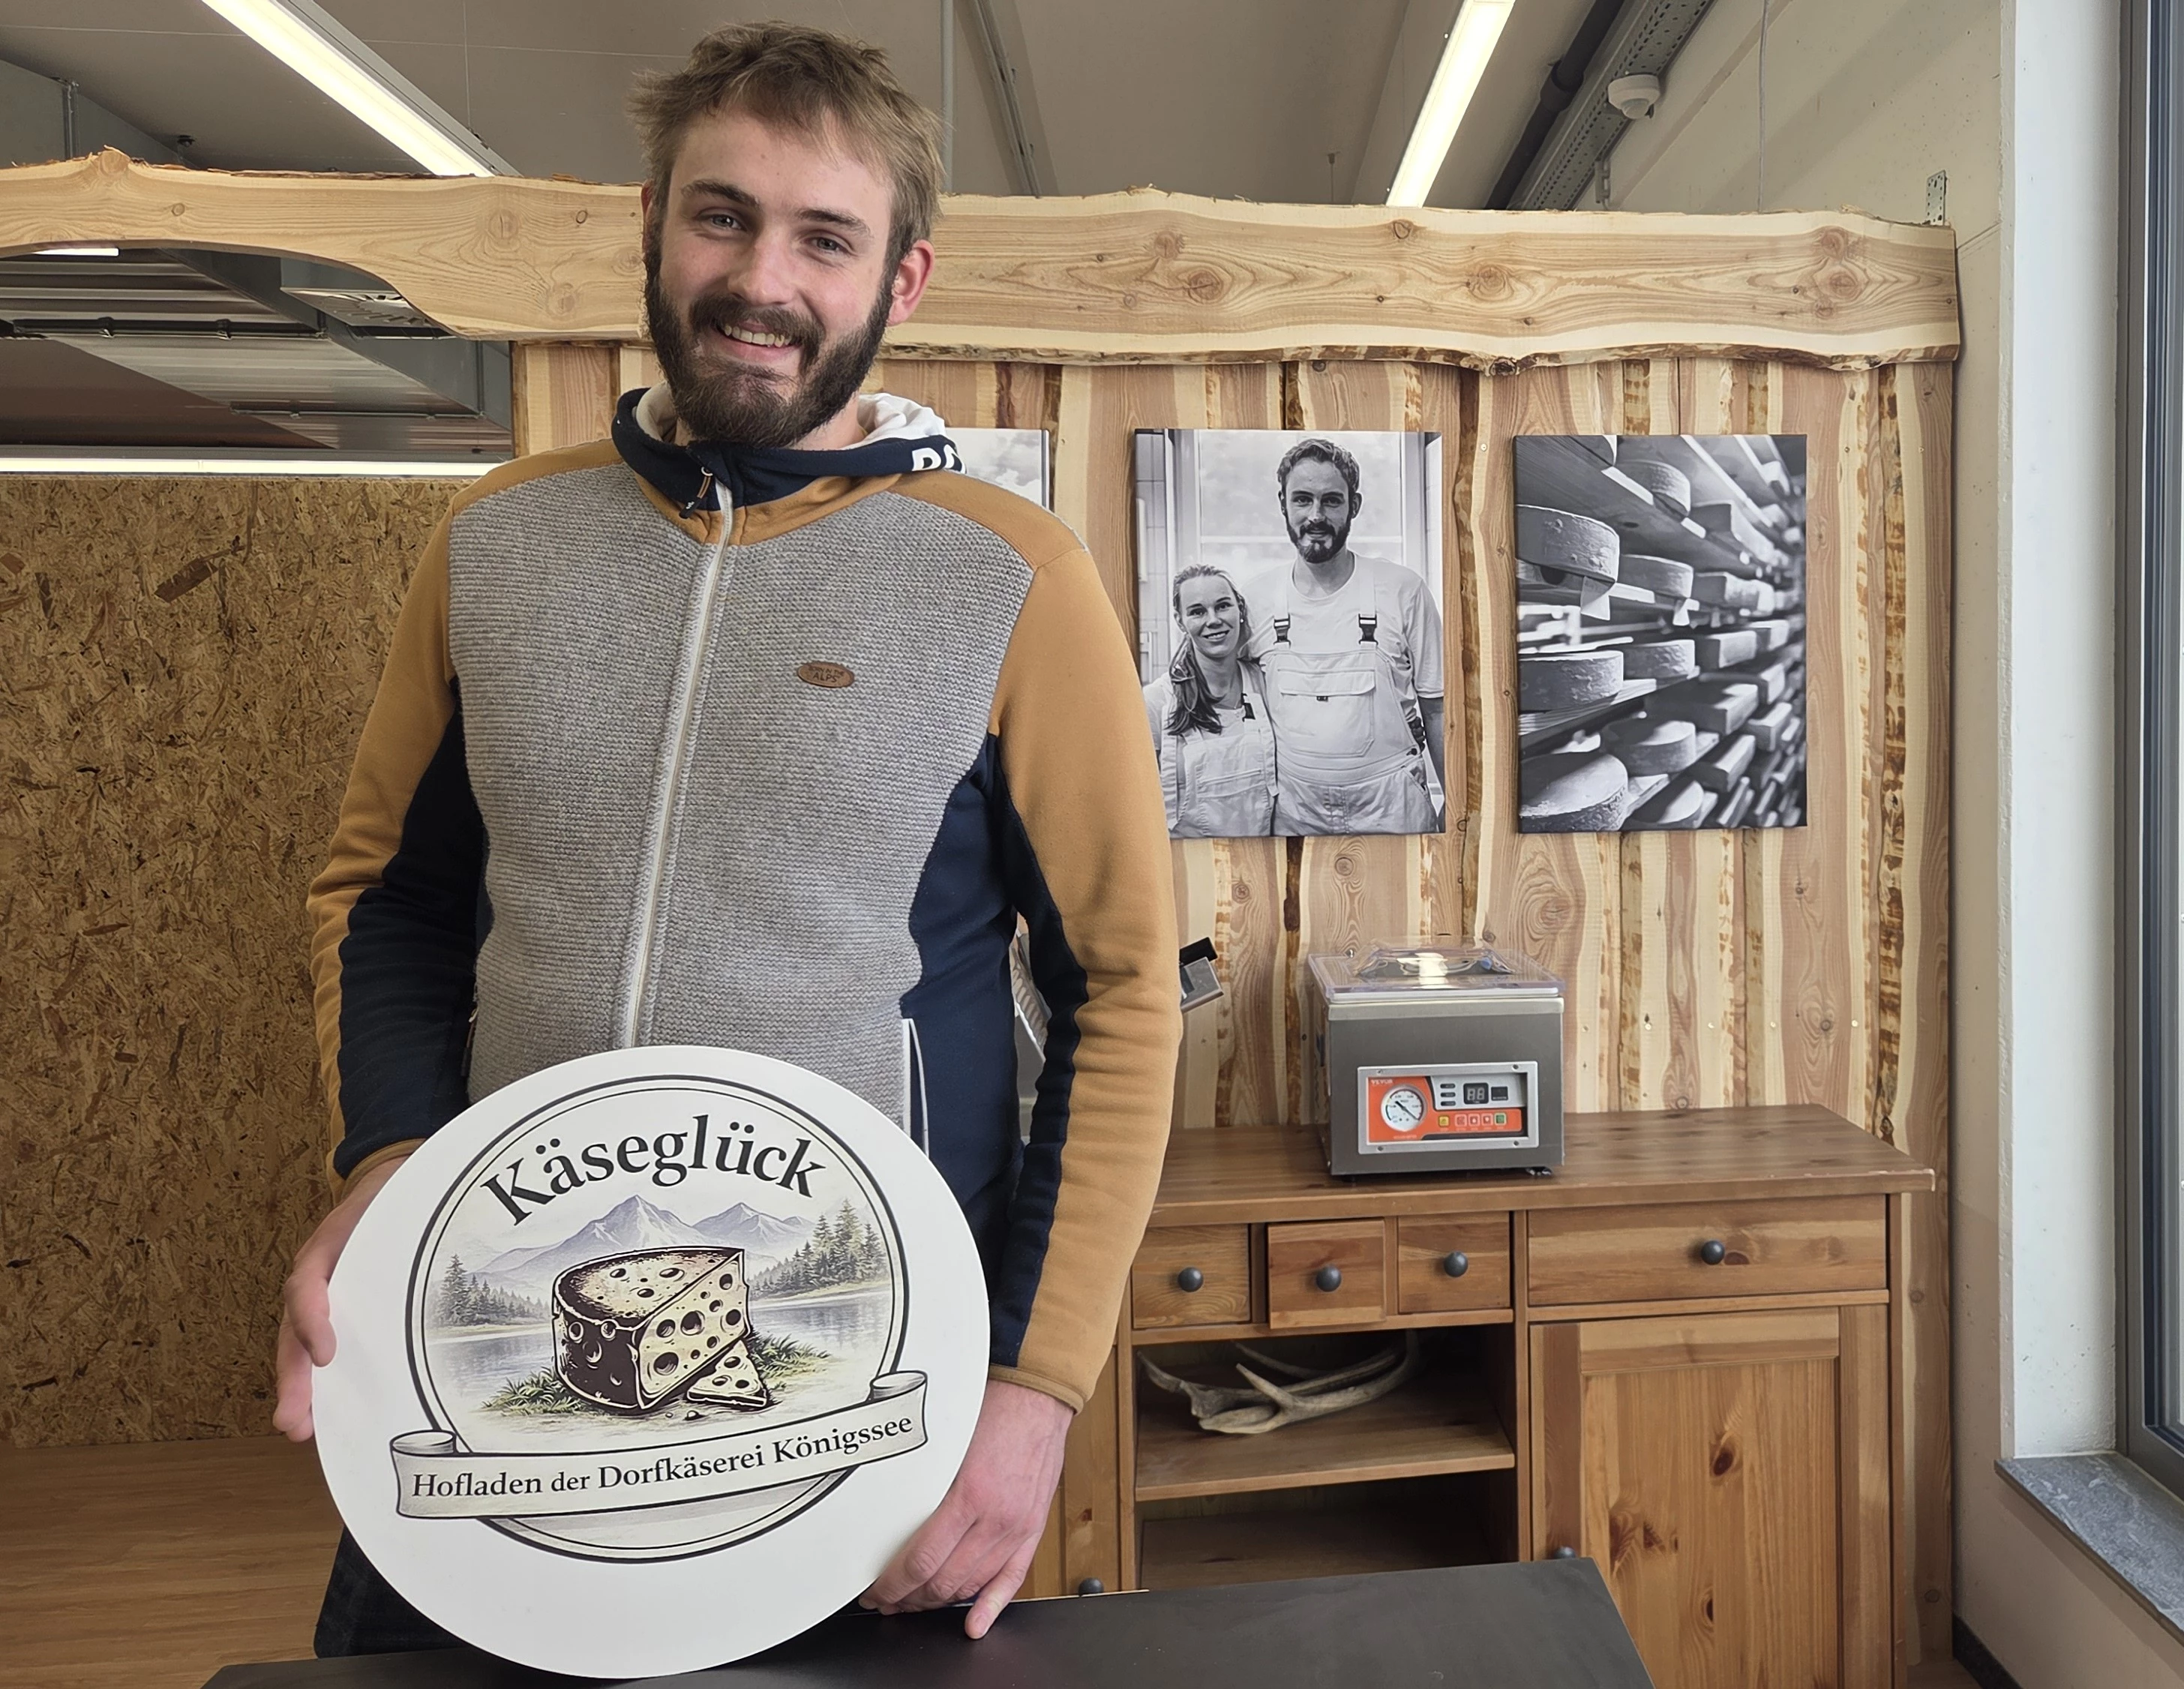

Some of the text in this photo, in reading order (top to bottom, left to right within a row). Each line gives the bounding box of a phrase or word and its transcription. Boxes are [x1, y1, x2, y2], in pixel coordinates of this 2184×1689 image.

[480, 1114, 826, 1226] Käseglück
[412, 1417, 914, 1497] Hofladen der Dorfkäserei Königssee
